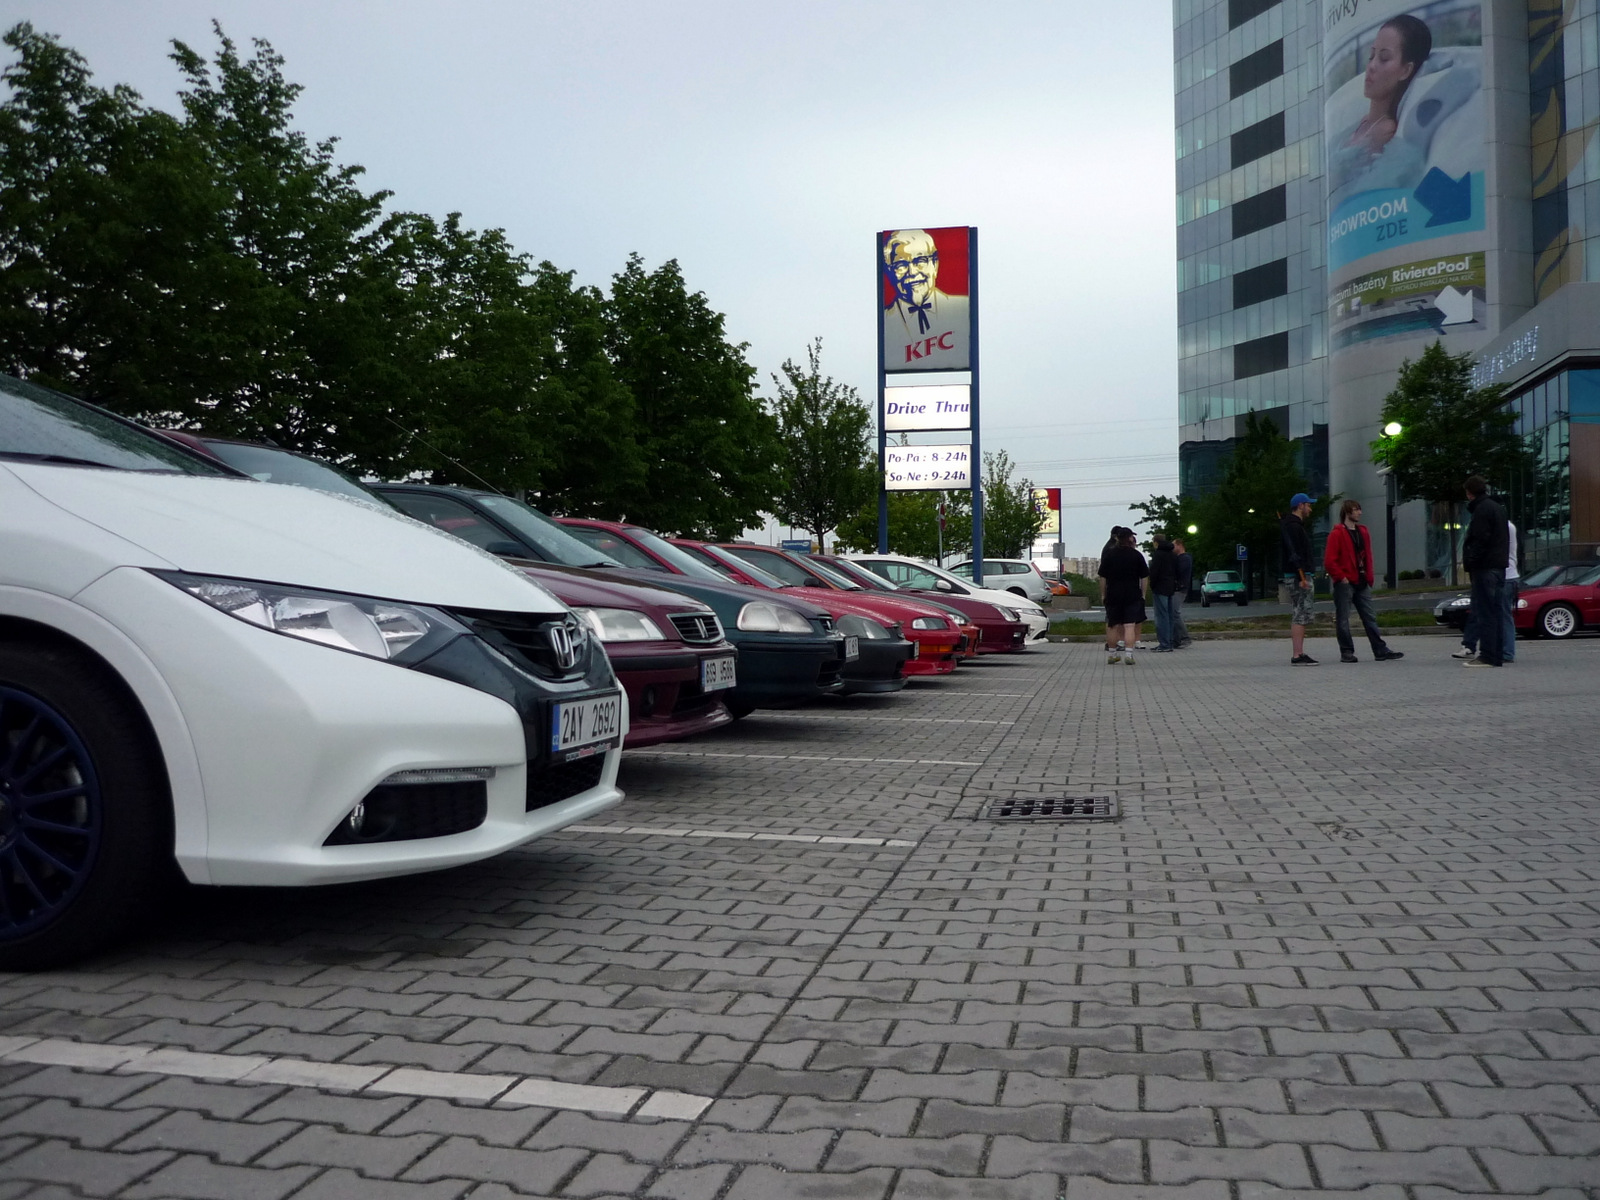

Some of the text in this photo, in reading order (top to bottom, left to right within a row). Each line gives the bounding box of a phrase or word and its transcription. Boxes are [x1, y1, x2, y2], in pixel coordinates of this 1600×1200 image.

[1331, 197, 1408, 243] SHOWROOM
[1376, 219, 1408, 242] ZDE
[1392, 256, 1470, 283] RivieraPool
[905, 331, 955, 363] KFC
[887, 401, 970, 415] Drive Thru
[562, 701, 616, 744] 2AY 2692
